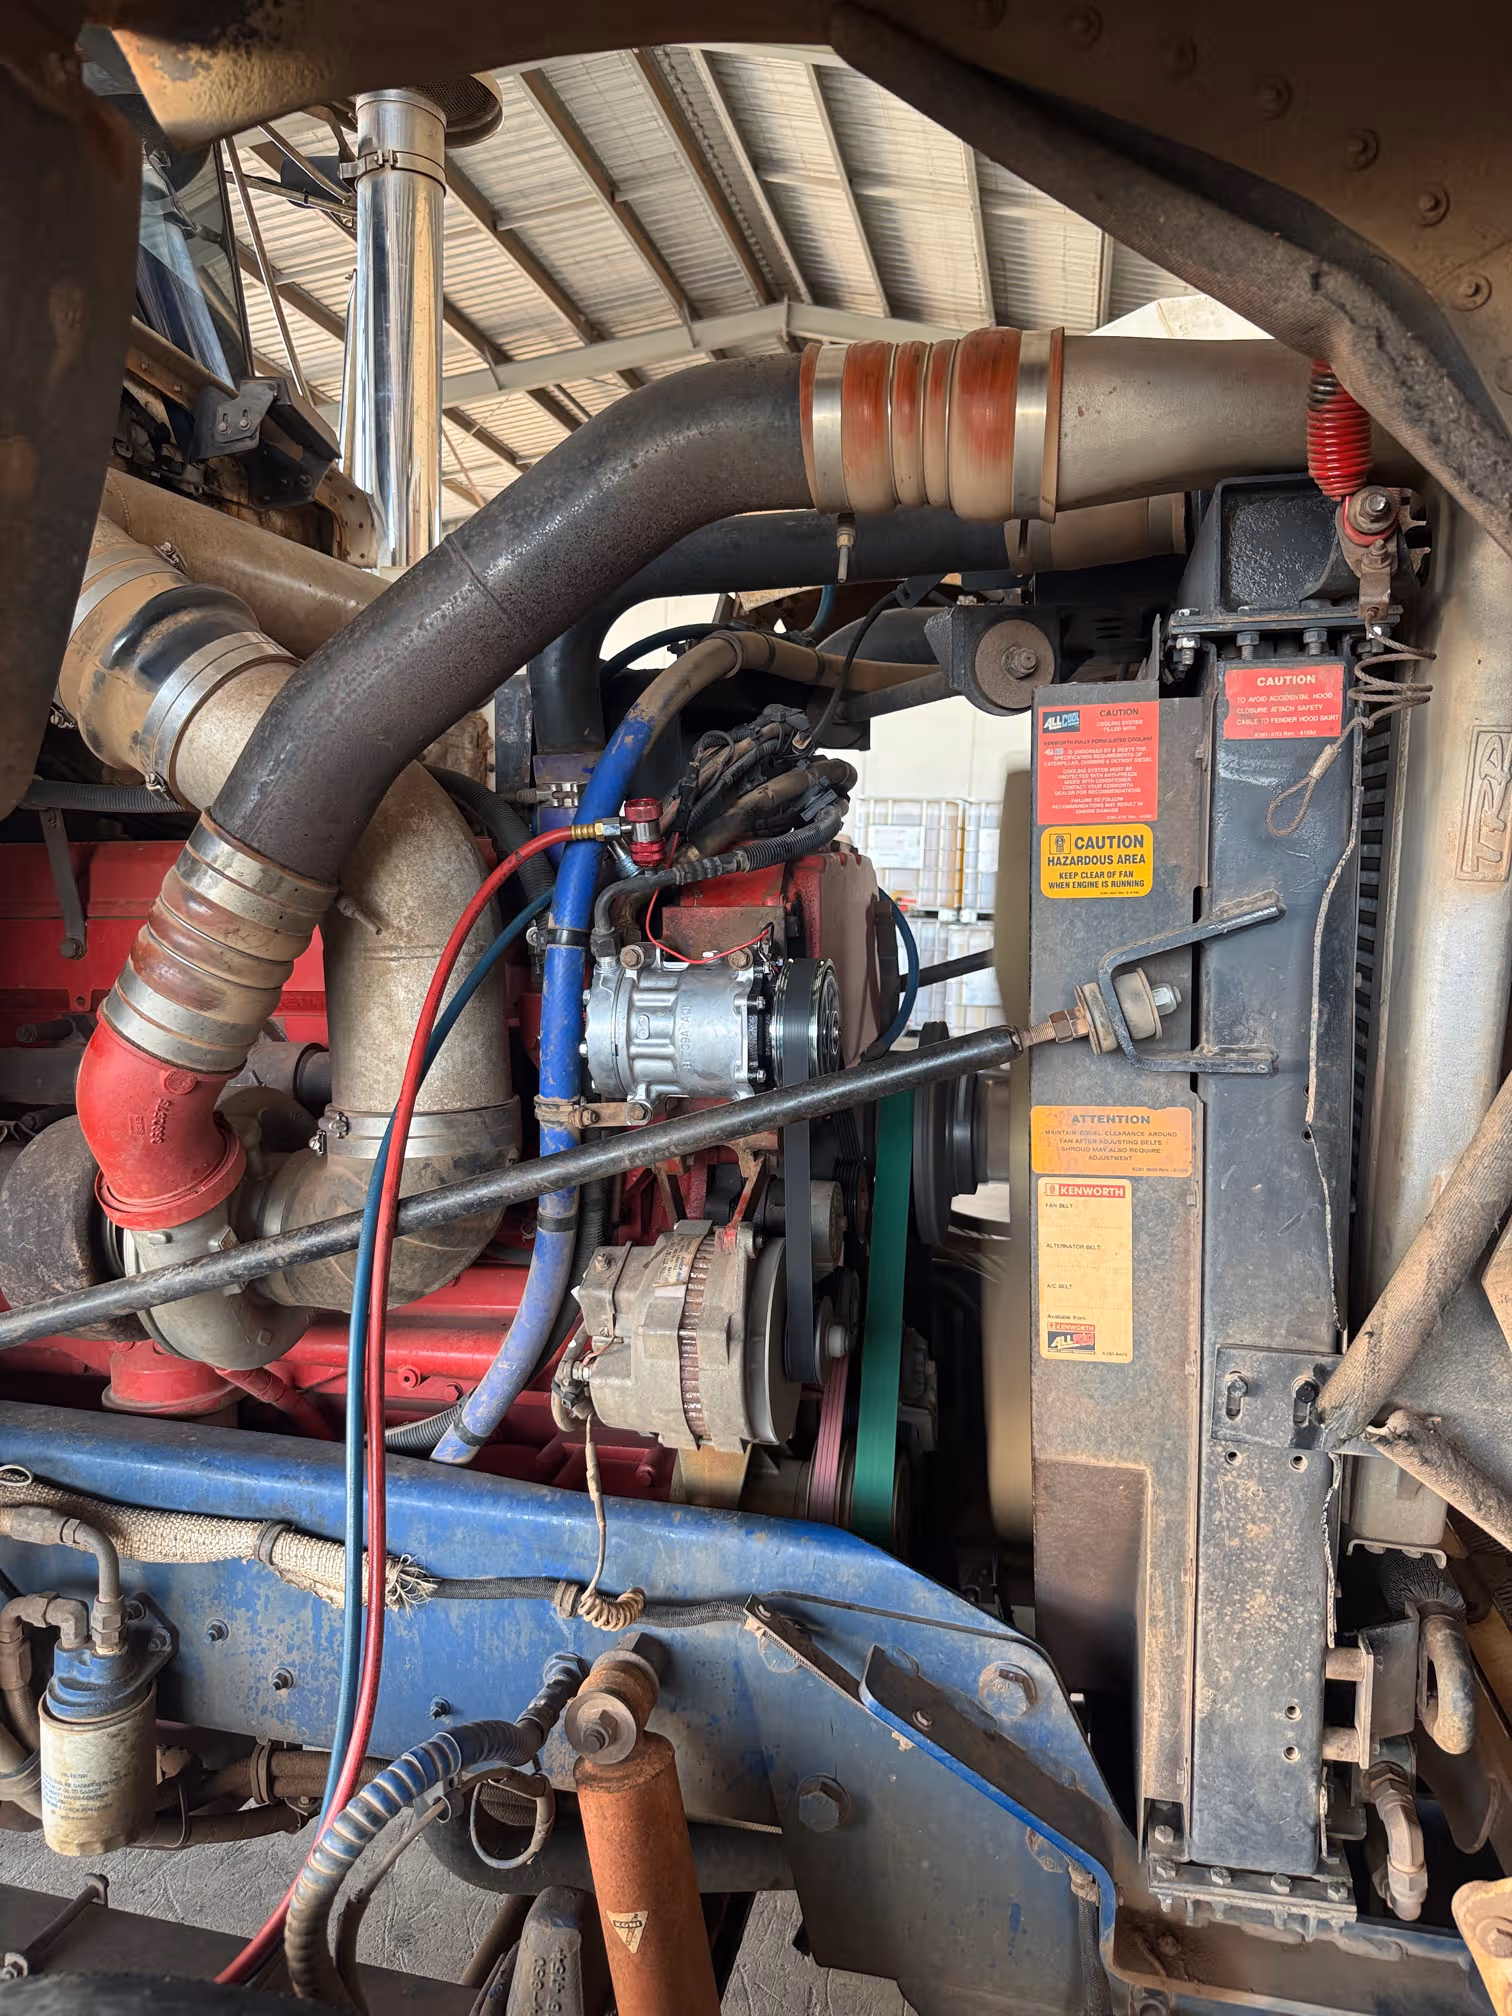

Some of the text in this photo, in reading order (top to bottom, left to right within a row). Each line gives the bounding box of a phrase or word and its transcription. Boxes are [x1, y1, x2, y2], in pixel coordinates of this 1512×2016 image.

[1256, 675, 1316, 686] CAUTION
[1099, 708, 1138, 717] CAUTION
[1074, 835, 1144, 850] CAUTION
[1048, 854, 1146, 866] HAZARDOUS AREA
[1072, 1115, 1150, 1124] ATTENTION
[1060, 1186, 1123, 1196] KENWORTH
